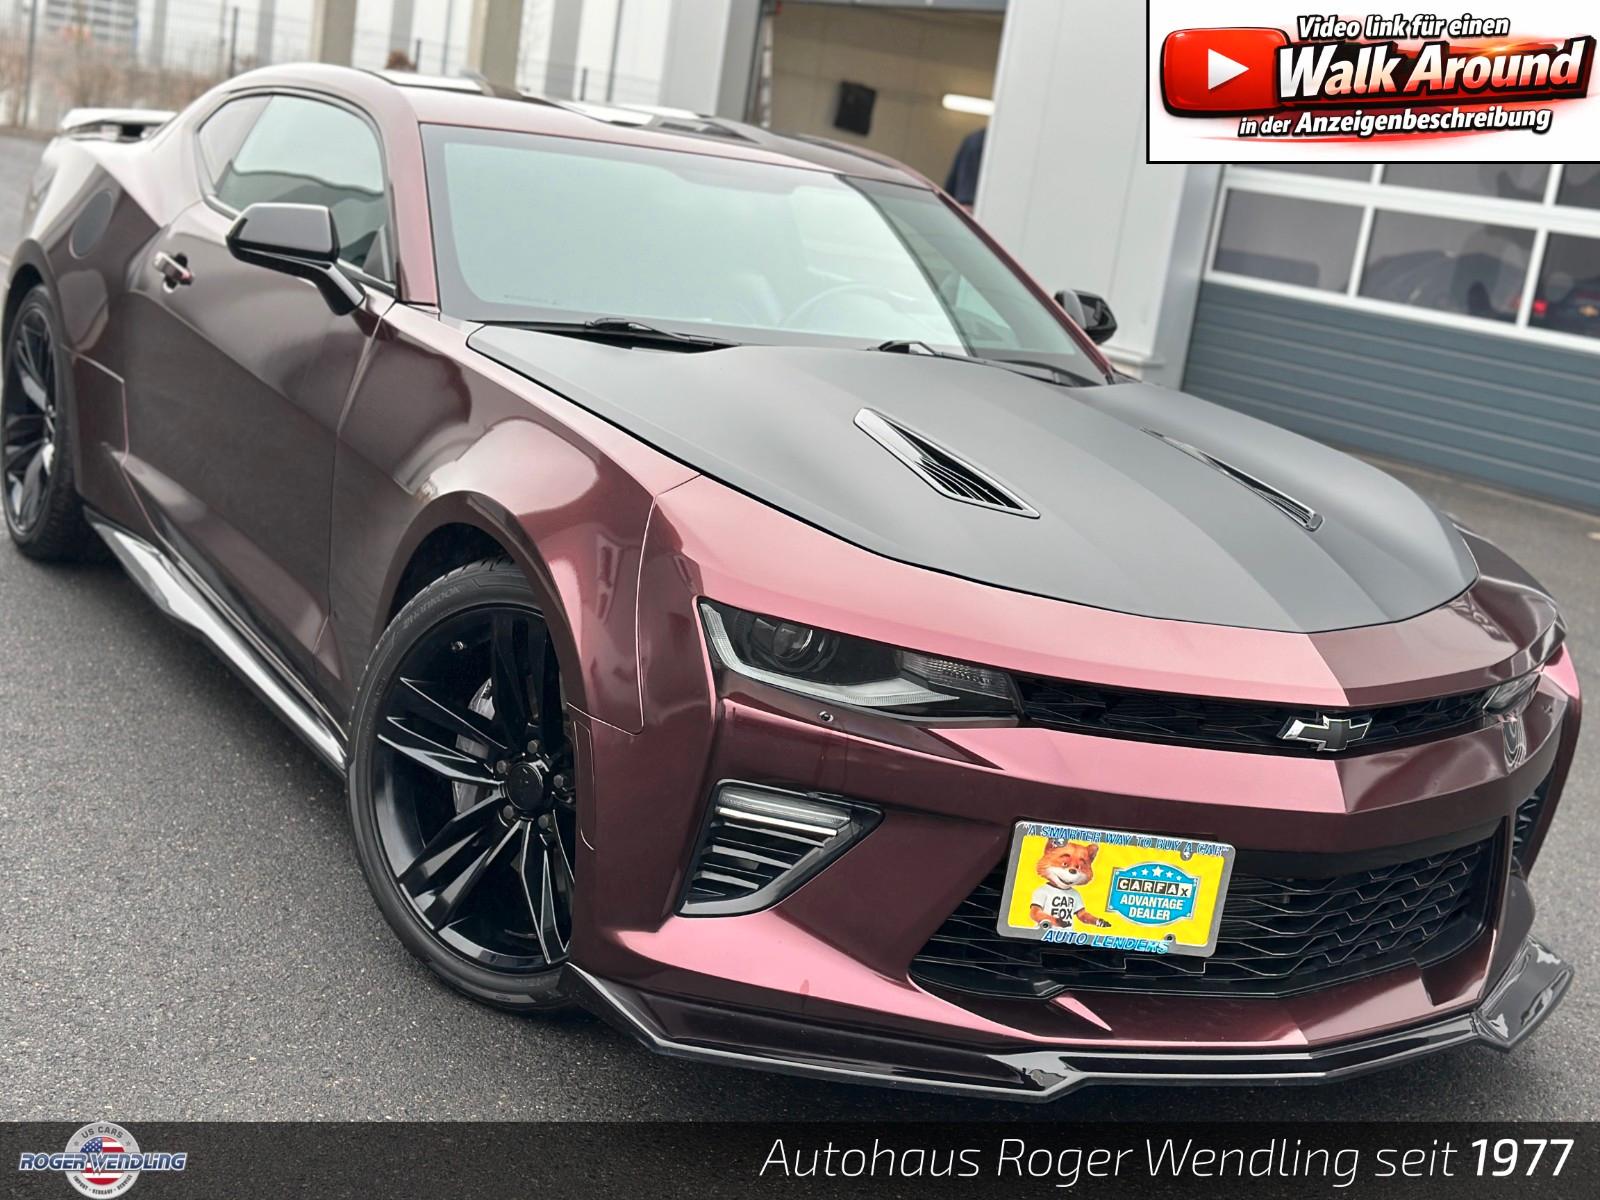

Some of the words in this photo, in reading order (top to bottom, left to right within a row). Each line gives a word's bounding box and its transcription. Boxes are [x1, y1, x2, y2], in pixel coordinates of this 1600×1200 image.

[1040, 825, 1101, 843] SMARTER
[1105, 832, 1132, 846] WAY
[1136, 836, 1152, 848] TO
[1156, 838, 1181, 851] BUY
[1184, 841, 1193, 853] A
[1052, 896, 1075, 908] CAR
[1120, 894, 1184, 910] ADVANTAGE
[1051, 908, 1073, 920] FOX
[1128, 907, 1171, 920] DEALER
[1041, 930, 1088, 945] AUTO
[1091, 935, 1169, 954] LENDERS
